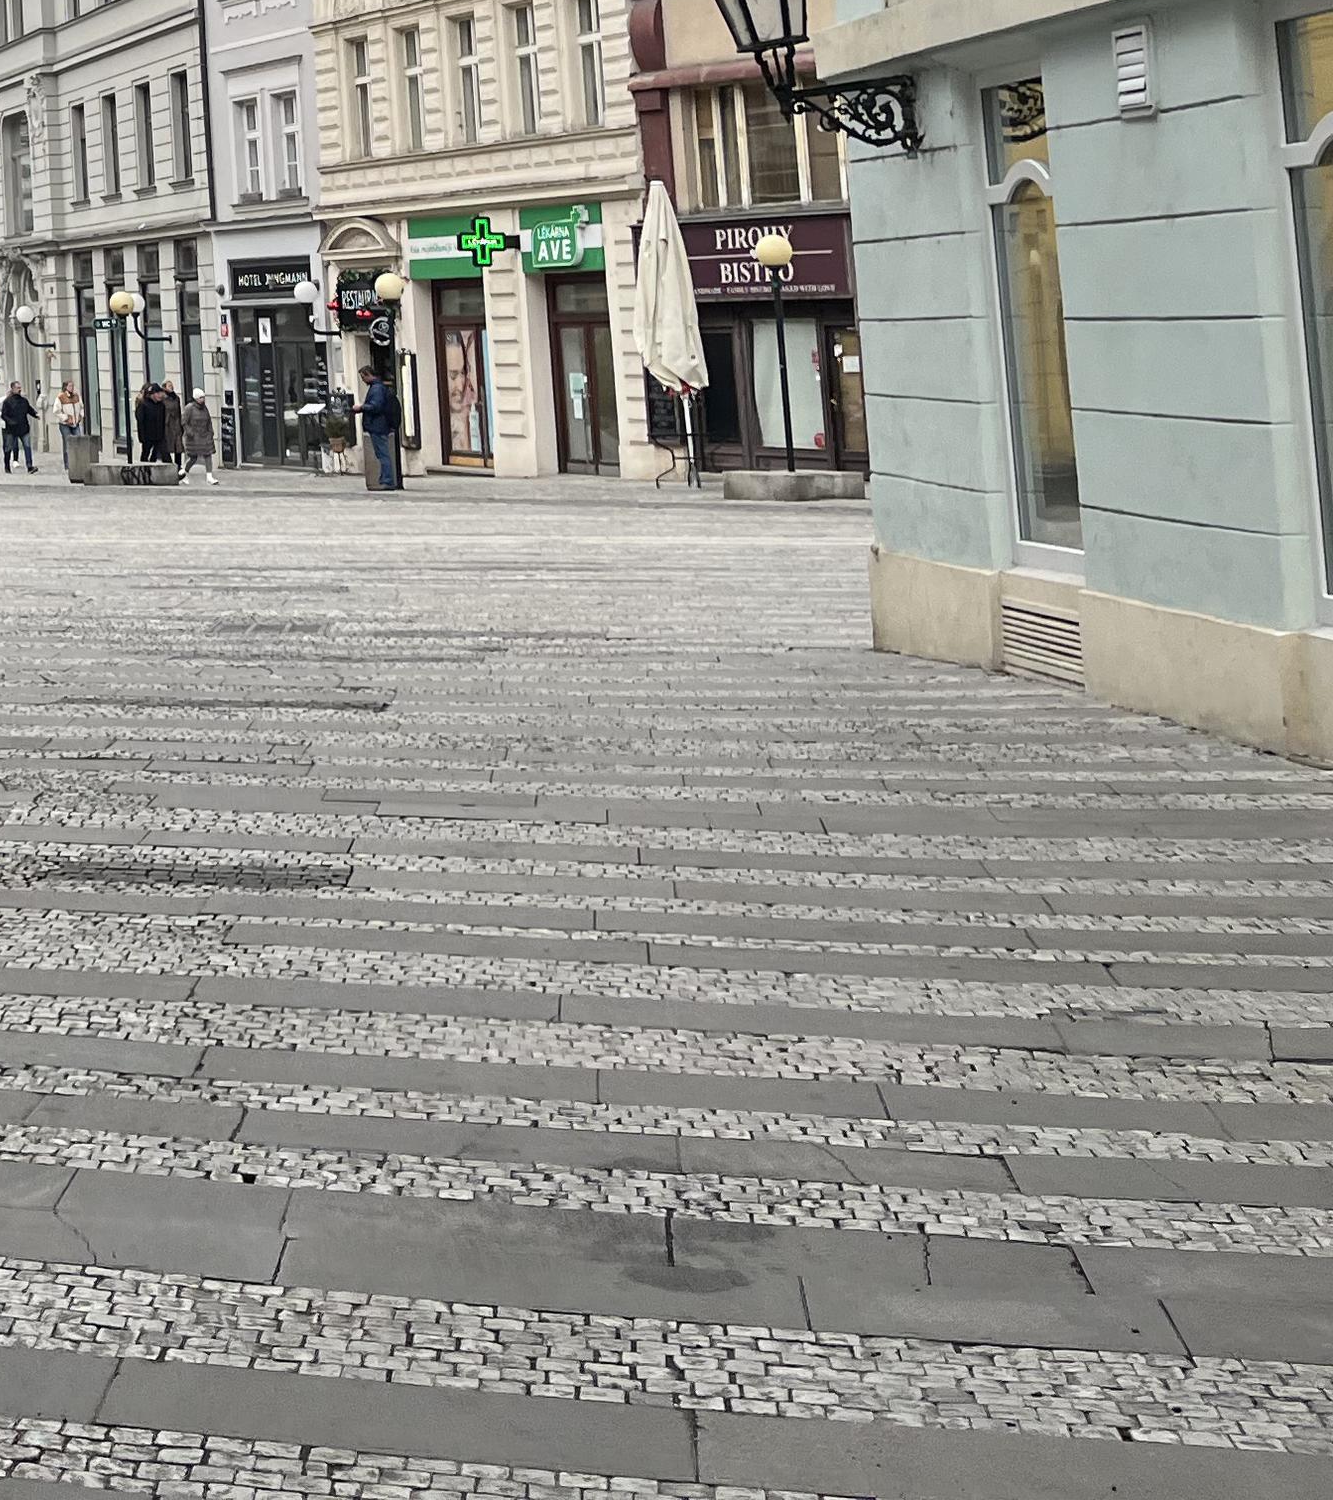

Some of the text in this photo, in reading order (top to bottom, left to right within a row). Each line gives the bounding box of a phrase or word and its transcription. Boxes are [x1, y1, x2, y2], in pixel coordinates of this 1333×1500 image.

[536, 224, 570, 240] LÉKÁRNA
[537, 239, 572, 262] AVE
[238, 273, 262, 287] HOTEL
[341, 290, 379, 310] RESTAURA
